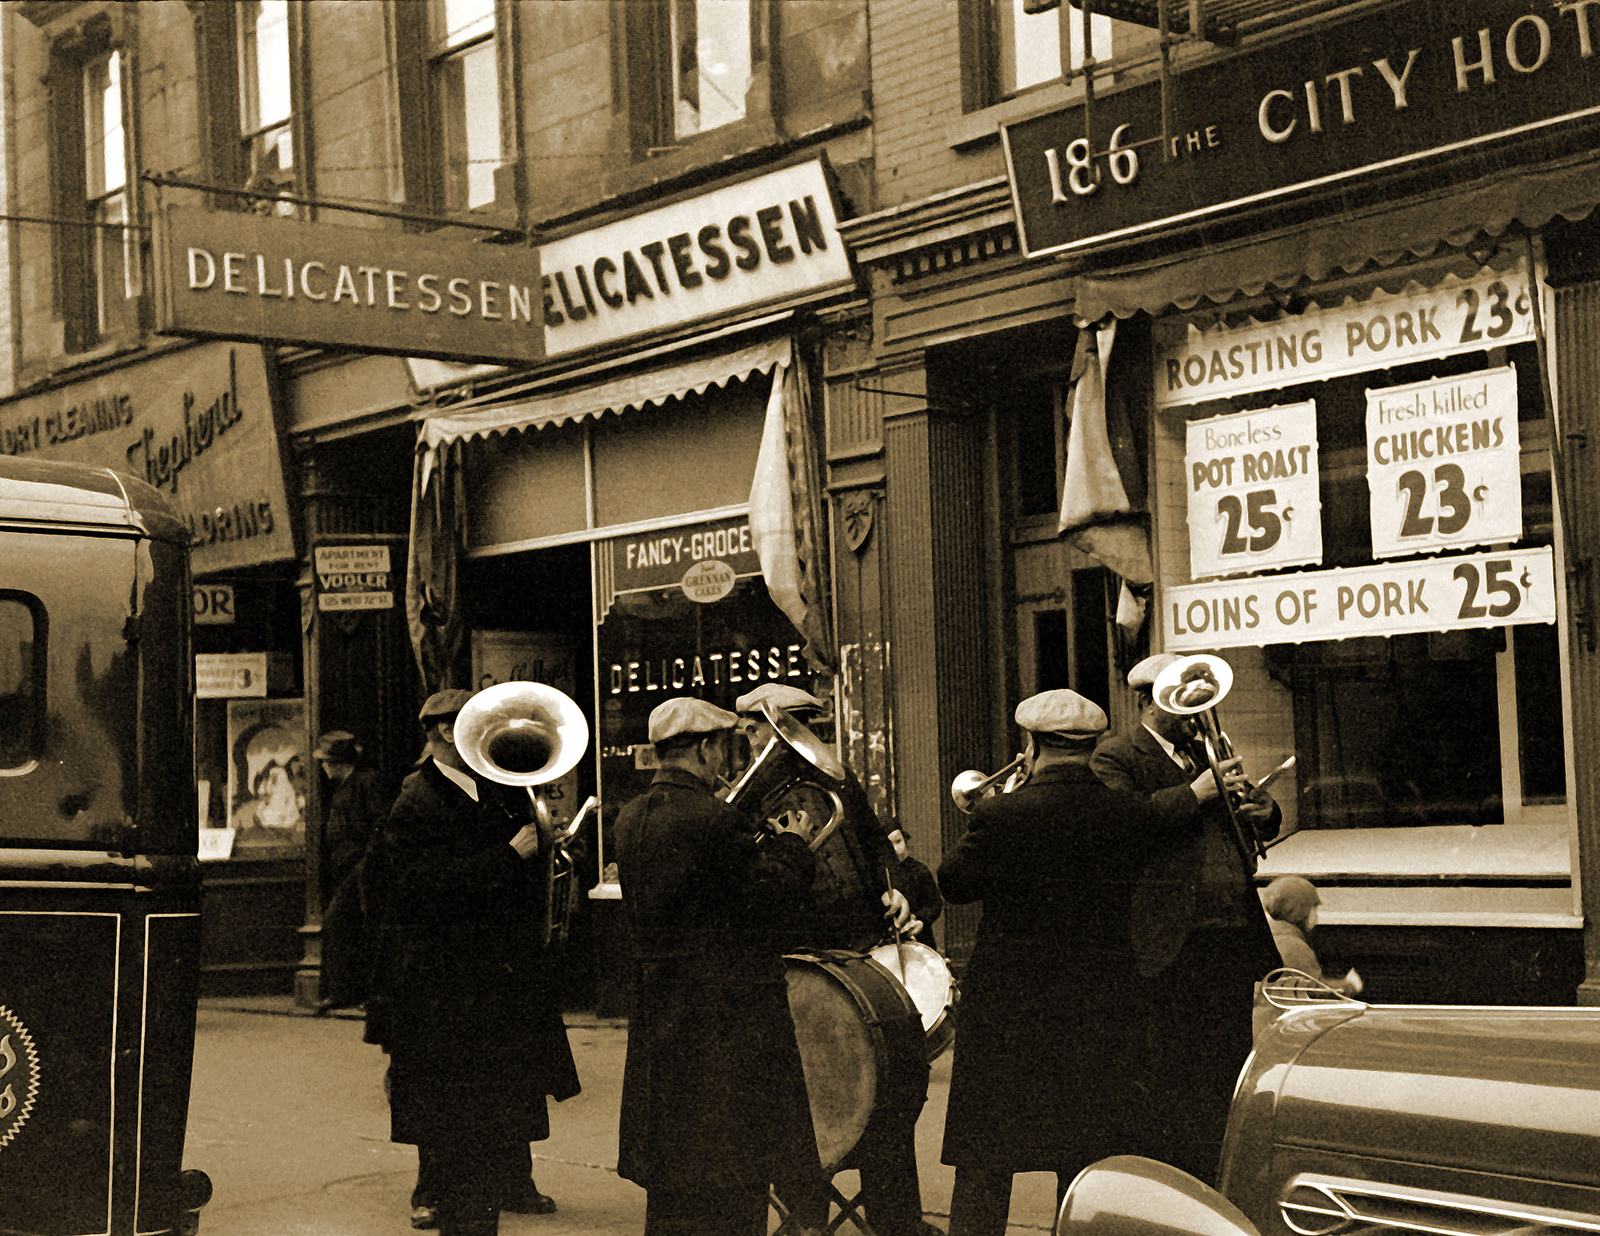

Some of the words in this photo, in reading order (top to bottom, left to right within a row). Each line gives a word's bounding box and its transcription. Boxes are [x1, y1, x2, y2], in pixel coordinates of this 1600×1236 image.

[1044, 123, 1139, 204] 186
[1170, 125, 1220, 158] THE
[1258, 48, 1423, 144] CITY
[1451, 0, 1600, 92] HOT
[187, 246, 532, 323] DELICATESSEN
[541, 194, 828, 328] ELICATESSEN
[1166, 328, 1323, 392] ROASTING
[1346, 305, 1442, 357] PORK
[1455, 281, 1532, 345] 23¢
[46, 395, 133, 445] CLEANING
[1204, 420, 1283, 452] Boneless
[1378, 392, 1427, 426] Fresh
[1433, 383, 1488, 416] killed
[1192, 460, 1235, 492] POT
[1243, 445, 1311, 483] ROAST
[1373, 415, 1505, 466] CHICKENS
[1216, 488, 1295, 557] 25¢
[1397, 462, 1490, 540] 23¢
[1173, 594, 1260, 635] LOINS
[1275, 589, 1318, 625] OF
[1338, 578, 1430, 621] PORK
[1453, 559, 1536, 619] 25¢
[611, 645, 822, 693] DELICATESSE
